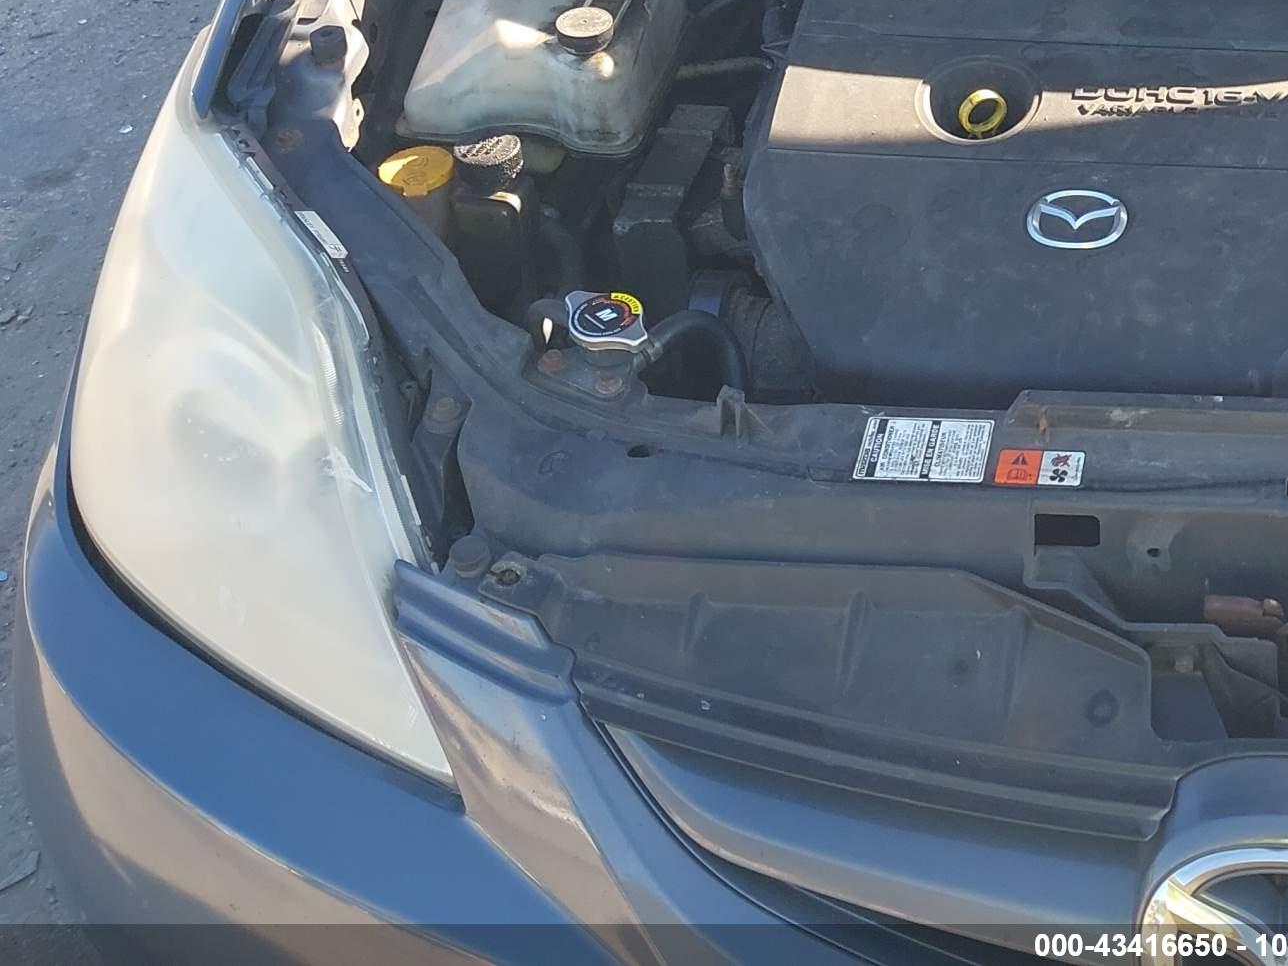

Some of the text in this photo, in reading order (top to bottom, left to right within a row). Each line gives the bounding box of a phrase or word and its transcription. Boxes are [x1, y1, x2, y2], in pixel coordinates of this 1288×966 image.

[870, 433, 884, 462] CAUTION
[921, 424, 940, 475] MISE EN GARDE
